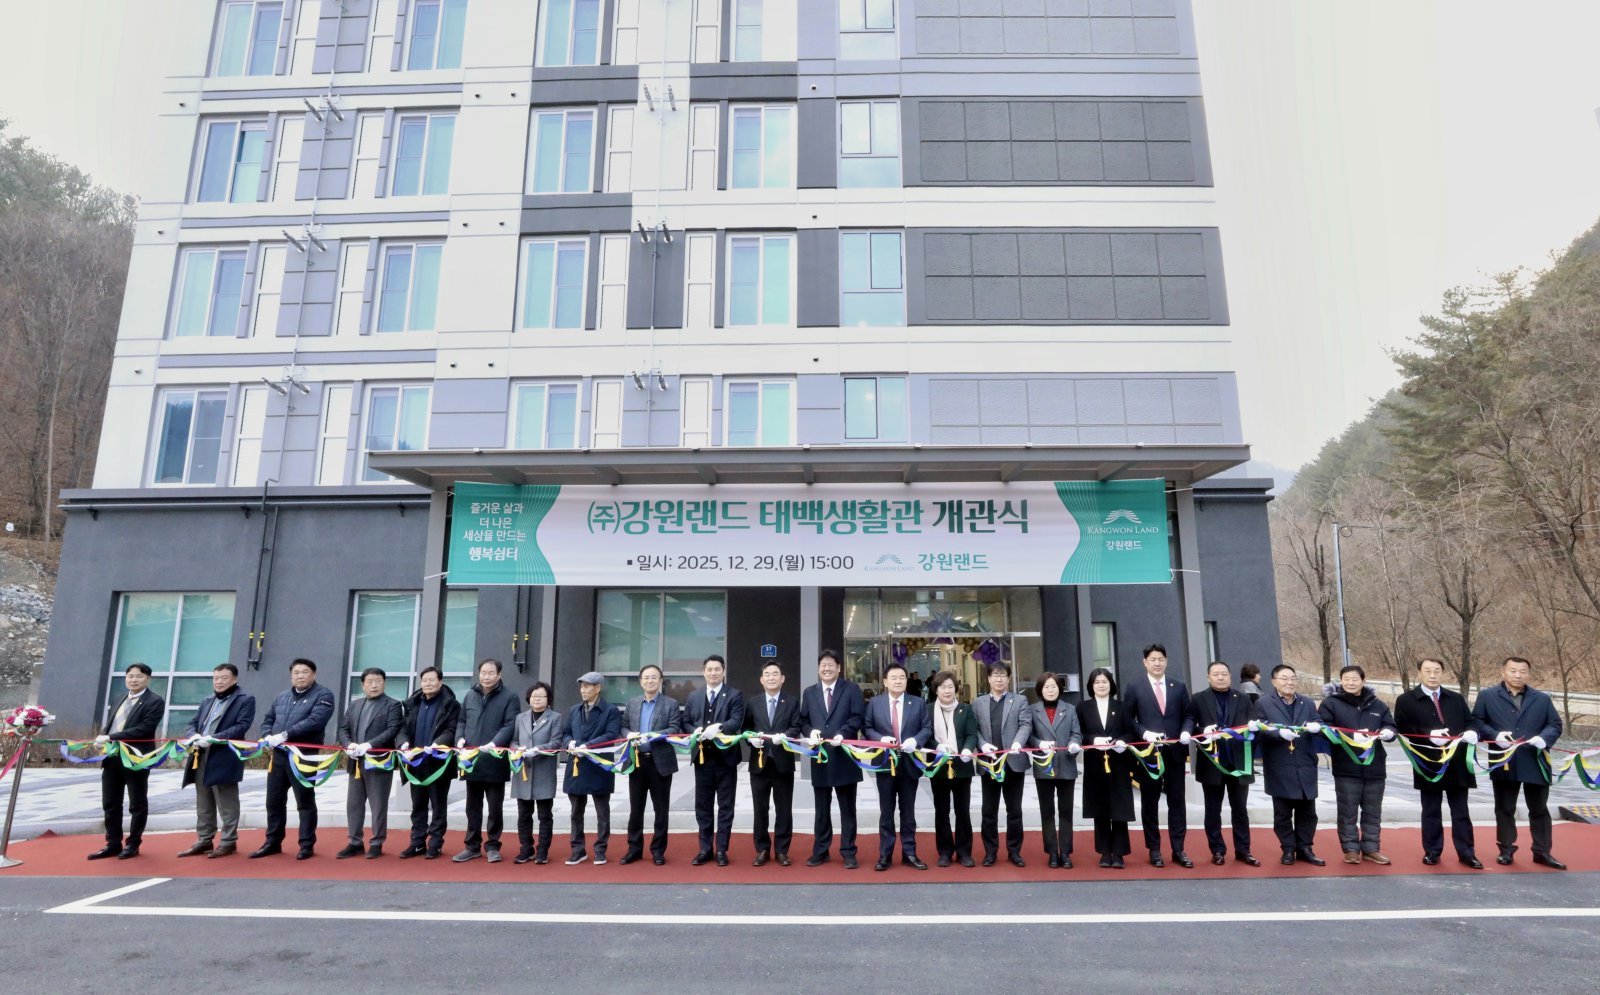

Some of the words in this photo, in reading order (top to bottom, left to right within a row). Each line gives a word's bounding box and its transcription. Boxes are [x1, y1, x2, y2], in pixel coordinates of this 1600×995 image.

[470, 502, 501, 514] 즐거운
[502, 502, 524, 514] 삶과
[479, 517, 490, 529] 더
[492, 517, 513, 529] 나은
[587, 499, 750, 535] (주)강원랜드
[759, 499, 924, 535] 태백생활관
[932, 498, 1029, 534] 개관식
[463, 529, 494, 542] 세상을
[496, 529, 527, 542] 만드는
[1087, 526, 1133, 534] KANGWON
[1105, 540, 1142, 551] 강원랜드
[469, 545, 518, 561] 행복쉼터
[636, 554, 673, 571] 일시:
[677, 555, 723, 571] 2025.
[727, 555, 748, 571] 12.
[753, 554, 805, 571] 29.(월)
[809, 555, 854, 570] 15:00
[917, 553, 990, 571] 강원랜드
